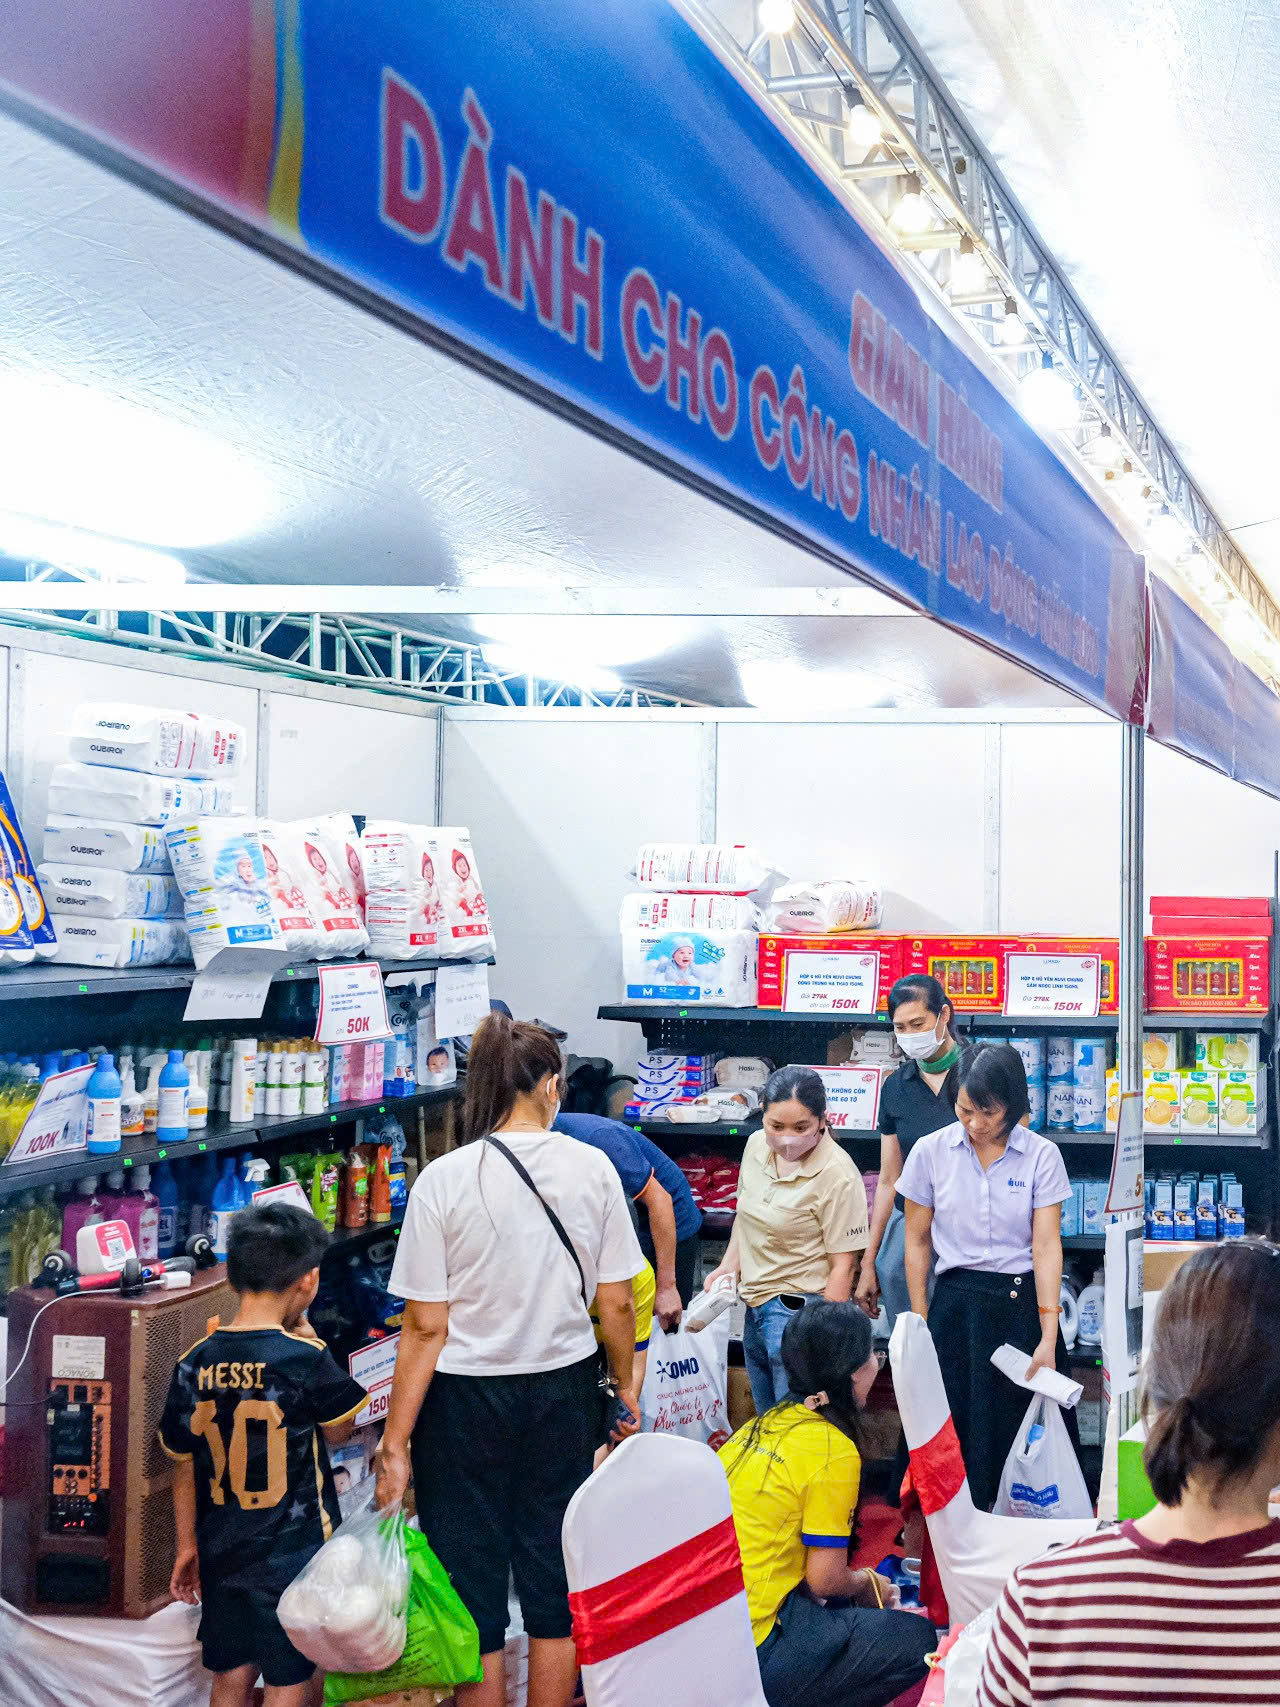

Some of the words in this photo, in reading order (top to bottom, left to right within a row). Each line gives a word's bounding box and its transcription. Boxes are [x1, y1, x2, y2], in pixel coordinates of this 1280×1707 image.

[380, 65, 604, 363] DÀNH
[620, 267, 739, 443] CHO
[750, 363, 862, 522] CÔNG
[868, 448, 941, 577] NHÂN
[946, 511, 986, 605] LAO
[989, 541, 1038, 641] ĐỘNG
[848, 289, 930, 450] GIAN
[90, 744, 122, 754] OUBIROI
[70, 846, 102, 856] OUBIROI
[61, 877, 92, 887] OUBIROI
[65, 927, 96, 936] OUBIROI
[235, 928, 243, 938] M
[643, 987, 653, 996] M
[831, 998, 860, 1009] 150K
[1053, 1001, 1083, 1011] 150K
[347, 1017, 370, 1034] 50K
[717, 1099, 735, 1107] Hasu
[1054, 1094, 1074, 1102] NAN
[25, 1130, 60, 1155] 100K
[669, 1357, 700, 1380] OMO
[57, 1369, 97, 1379] SONACO
[197, 1362, 267, 1391] MESSI
[190, 1400, 288, 1510] 10
